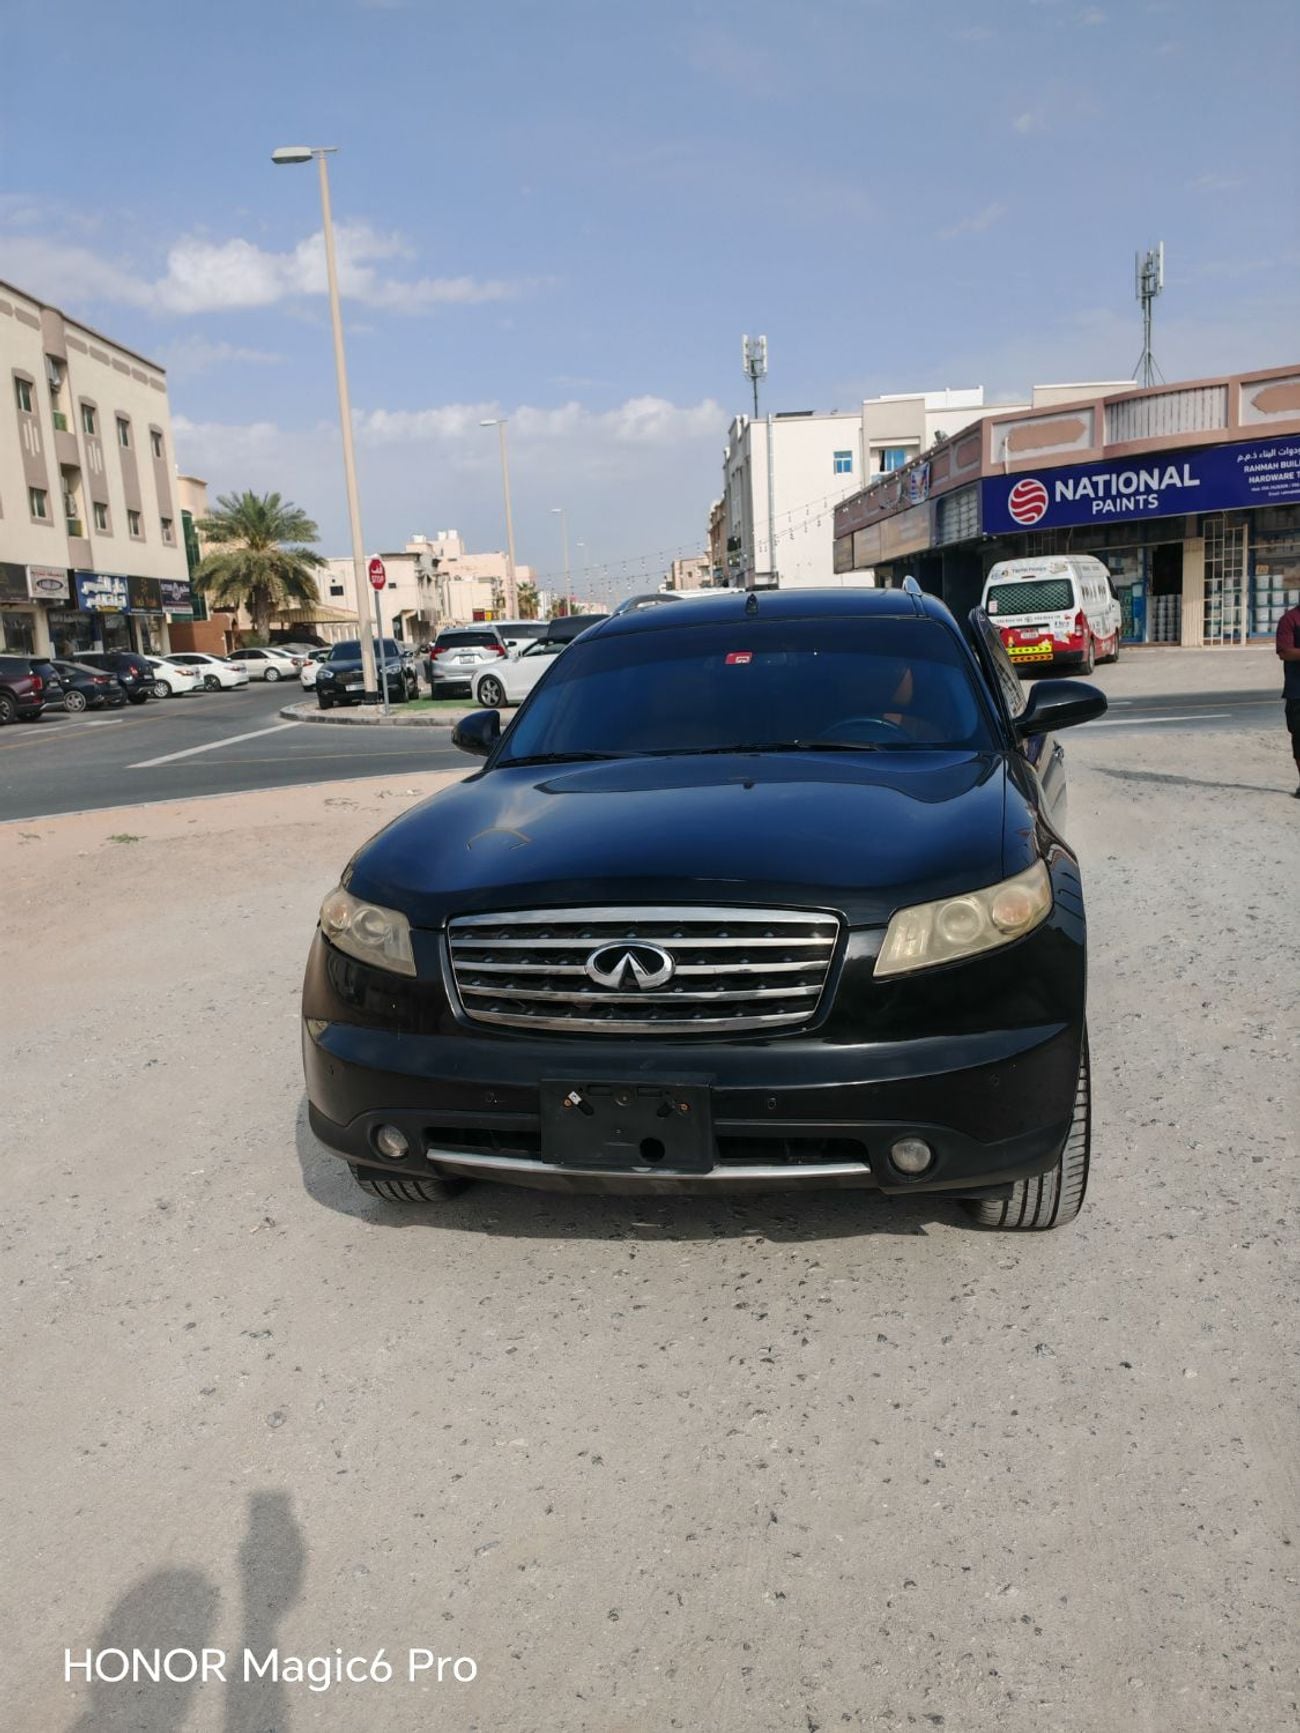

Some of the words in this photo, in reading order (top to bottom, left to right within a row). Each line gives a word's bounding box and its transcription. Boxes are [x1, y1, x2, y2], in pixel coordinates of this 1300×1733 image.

[1244, 462, 1279, 472] RAHMAH
[1055, 464, 1200, 502] NATIONAL
[1248, 472, 1294, 484] HARDWARE
[1092, 493, 1158, 515] PAINTS
[371, 575, 384, 584] STOP
